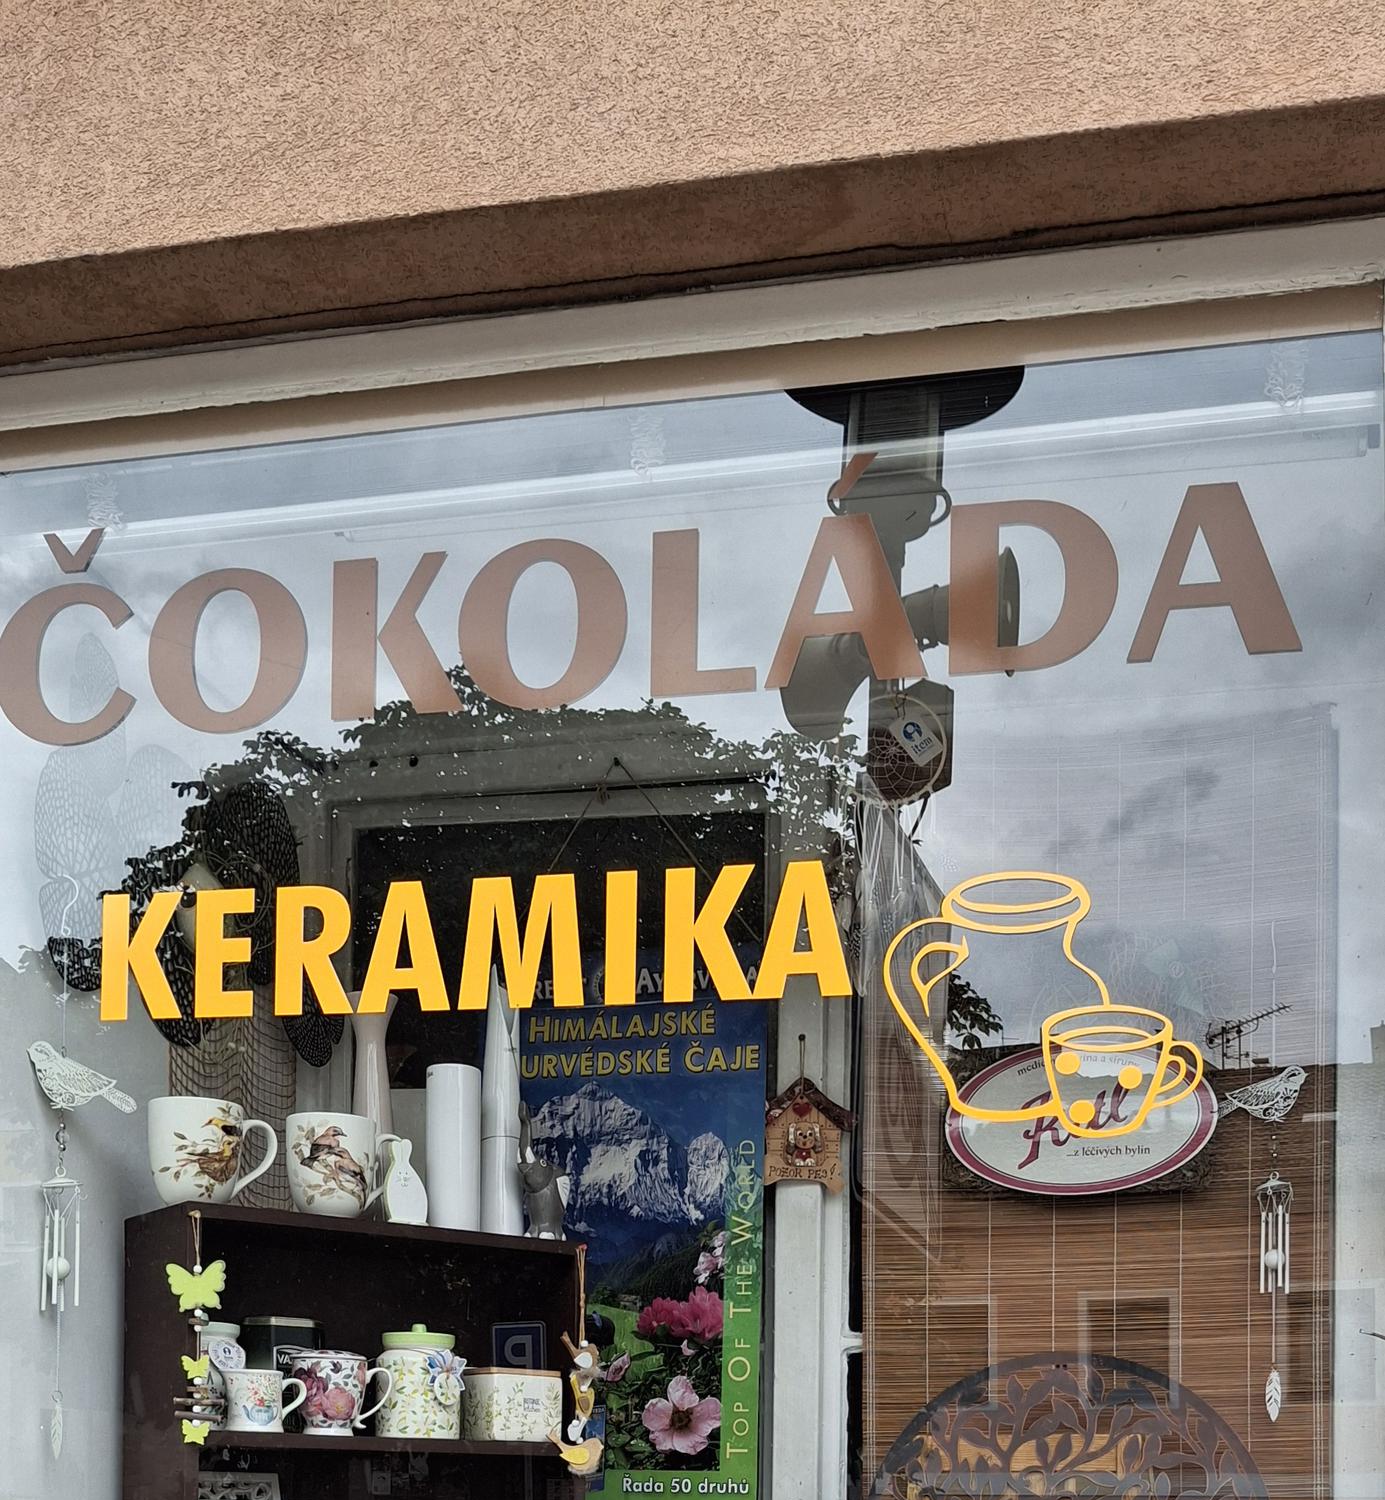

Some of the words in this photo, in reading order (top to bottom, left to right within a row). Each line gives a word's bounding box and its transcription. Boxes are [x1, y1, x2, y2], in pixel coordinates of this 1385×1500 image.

[0, 452, 1302, 746] ČOKOLÁDA
[100, 860, 852, 1021] KERAMIKA
[528, 1003, 716, 1043] HIMÁLAJSKÉ
[684, 1041, 760, 1073] ČAJE
[1125, 1145, 1151, 1158] bylin
[731, 1139, 756, 1246] WORLD
[729, 1263, 753, 1319] THE
[727, 1337, 751, 1382] OF
[726, 1402, 750, 1459] TOP
[622, 1474, 664, 1493] Řada
[670, 1478, 691, 1493] 50
[698, 1478, 749, 1494] druhů
